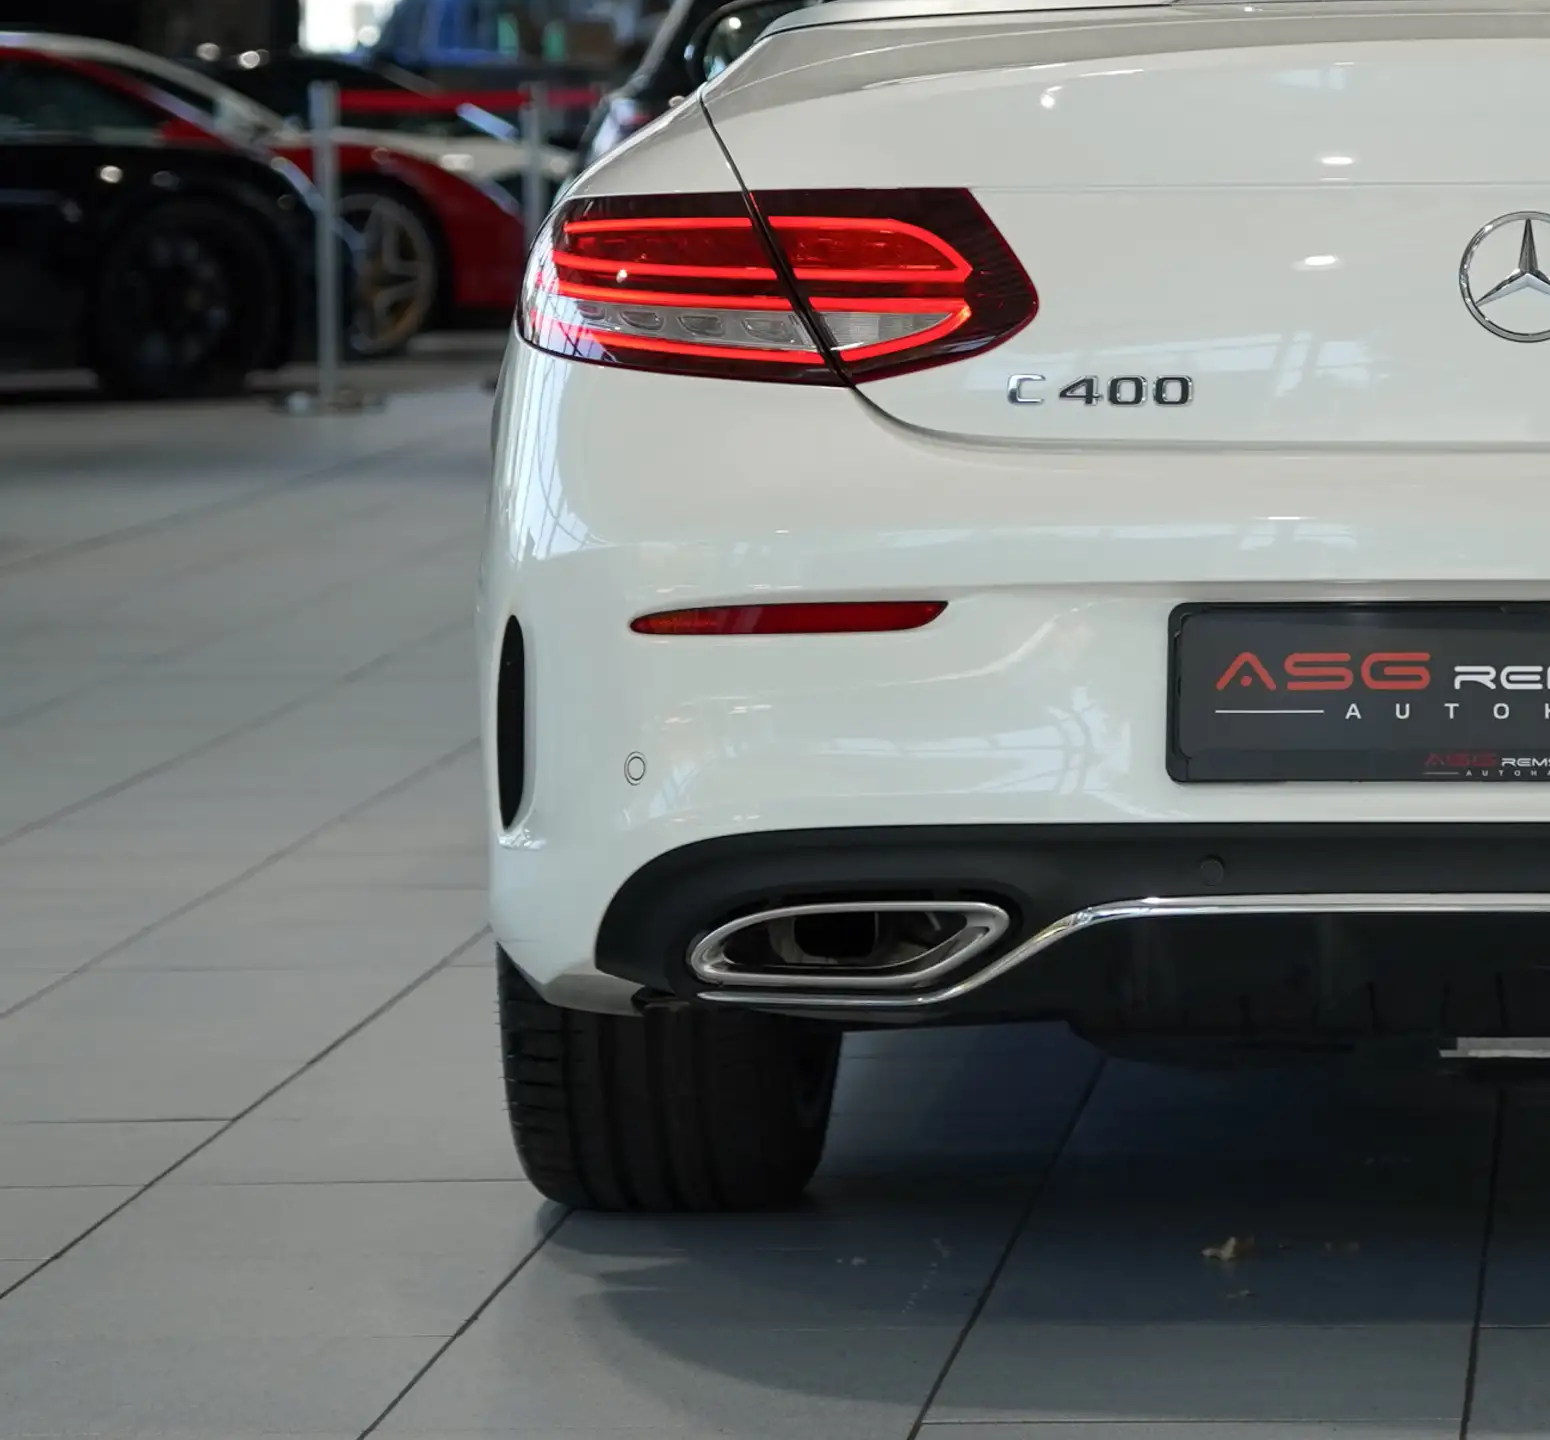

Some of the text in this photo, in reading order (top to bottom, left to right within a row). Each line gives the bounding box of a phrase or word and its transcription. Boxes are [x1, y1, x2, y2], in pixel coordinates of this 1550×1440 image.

[1007, 374, 1194, 406] C 400
[1216, 652, 1431, 690] ASG
